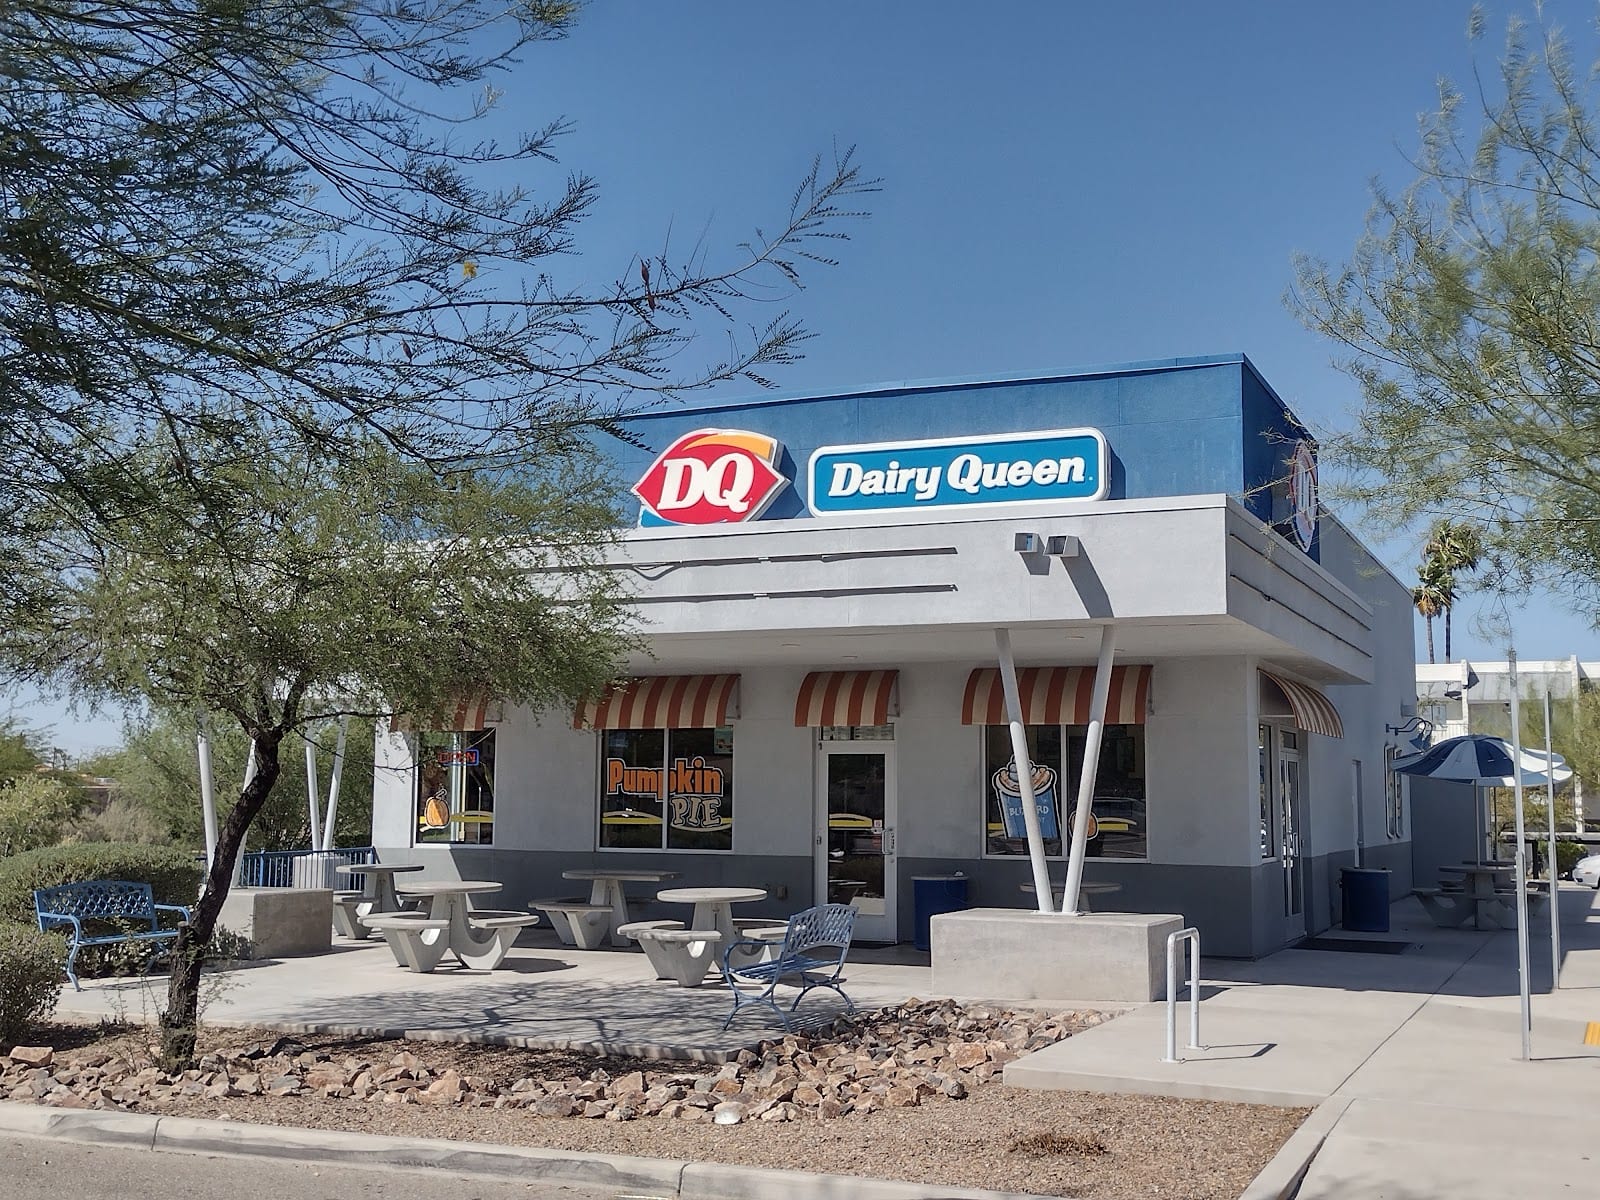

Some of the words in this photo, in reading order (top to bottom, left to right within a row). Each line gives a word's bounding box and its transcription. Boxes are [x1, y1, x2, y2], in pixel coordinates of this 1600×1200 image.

[656, 452, 750, 513] DQ
[828, 461, 942, 500] Dairy
[947, 454, 1085, 494] Queen
[607, 757, 723, 802] Pumpkin
[671, 797, 721, 827] PIE
